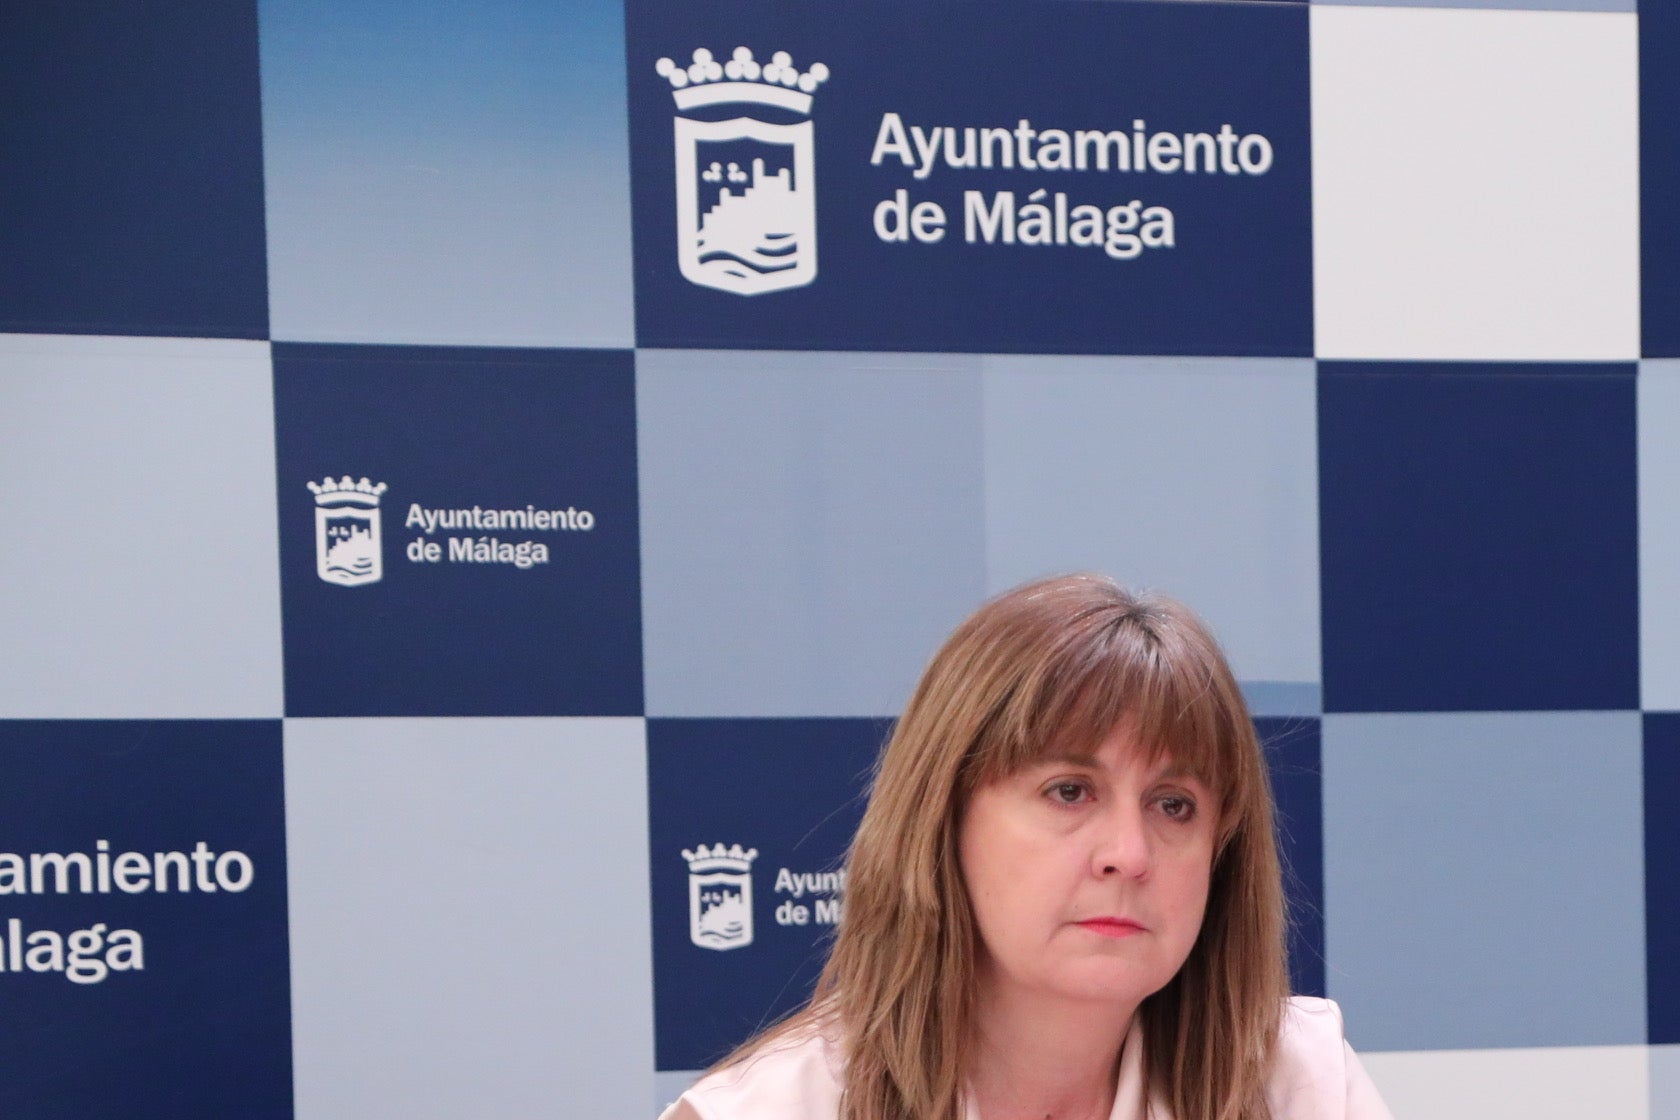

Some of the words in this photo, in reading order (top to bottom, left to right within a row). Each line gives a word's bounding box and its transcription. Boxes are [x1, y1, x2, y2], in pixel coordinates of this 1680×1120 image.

[870, 112, 1273, 180] Ayuntamiento
[872, 188, 947, 245] de
[963, 187, 1175, 260] Málaga
[405, 503, 596, 535] Ayuntamiento
[406, 537, 442, 563] de
[448, 536, 549, 569] Málaga
[775, 900, 810, 926] de
[0, 918, 145, 985] laga
